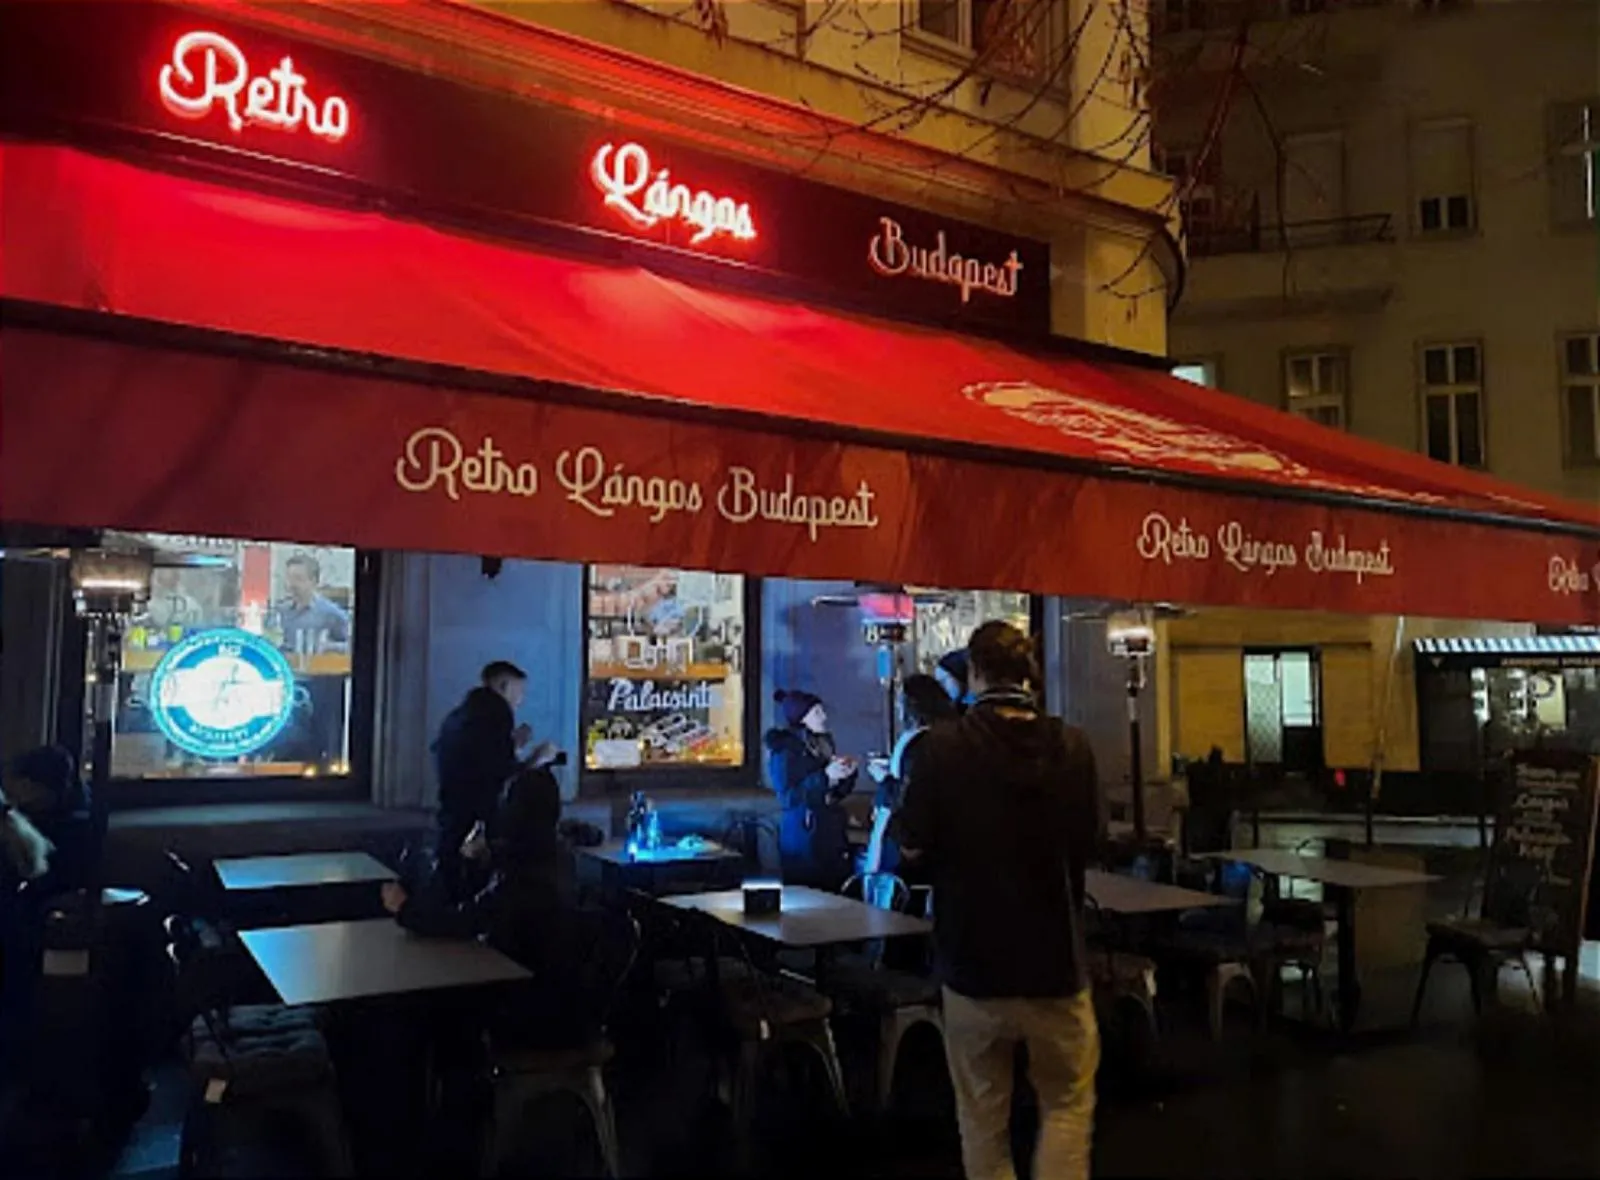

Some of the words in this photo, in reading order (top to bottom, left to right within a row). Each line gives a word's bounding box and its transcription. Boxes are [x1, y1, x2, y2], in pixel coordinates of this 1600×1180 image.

[160, 31, 348, 138] Retro
[592, 142, 757, 244] Lángos
[869, 216, 1024, 302] Budapest
[396, 427, 538, 499] Retro
[555, 446, 702, 522] Lángos
[717, 466, 878, 541] Budapest
[1136, 512, 1210, 566] Retro
[1305, 531, 1395, 585] Budapest
